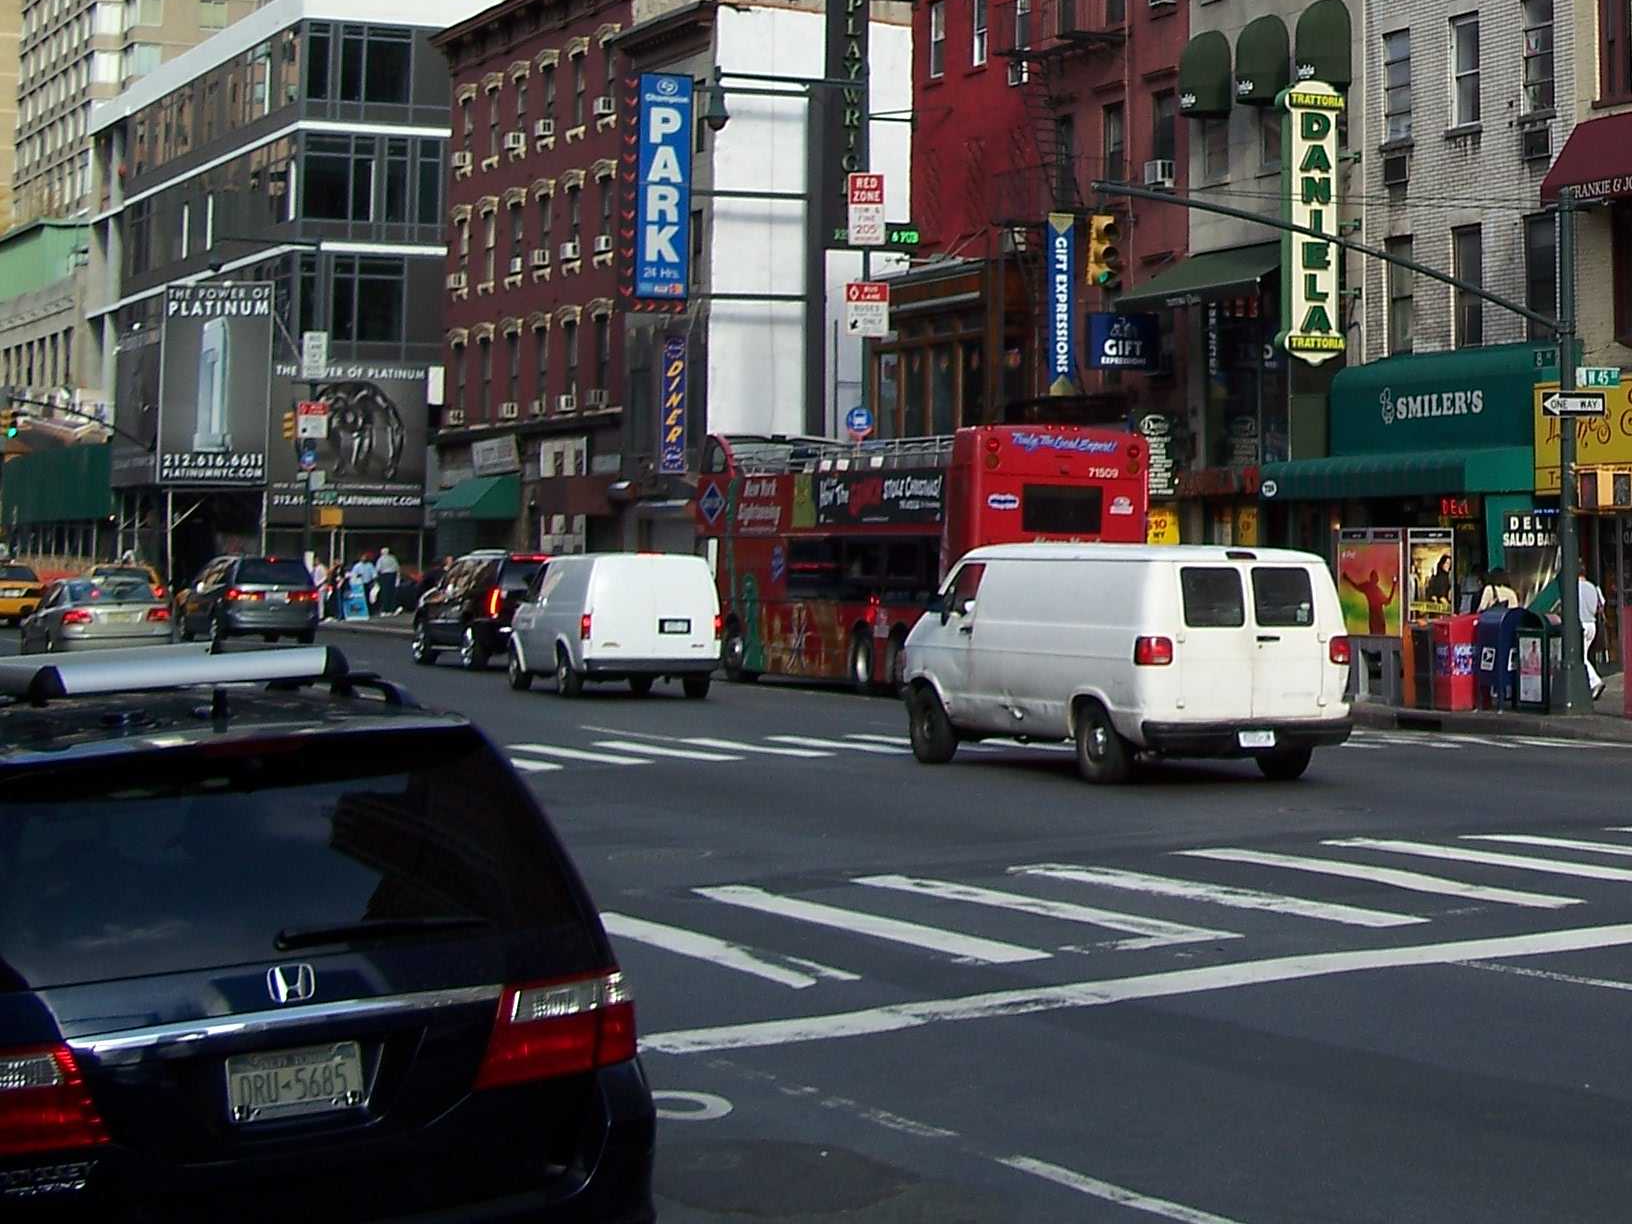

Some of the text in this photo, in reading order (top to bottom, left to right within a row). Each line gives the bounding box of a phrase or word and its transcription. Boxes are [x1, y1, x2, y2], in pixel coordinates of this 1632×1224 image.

[644, 92, 690, 105] Champion
[1290, 93, 1345, 107] TRATTORIA
[645, 106, 683, 264] PARK
[855, 177, 878, 189] RED
[1569, 179, 1611, 200] FRANKIE
[1612, 178, 1622, 193] &
[853, 190, 881, 202] ZONE
[1299, 111, 1333, 333] DANIELA
[643, 266, 657, 278] 24
[168, 287, 272, 300] THE POWER OF
[167, 300, 270, 317] PLATINUM
[1055, 236, 1069, 374] GIFT EXPRESSIONS
[1103, 338, 1144, 357] GIFT
[1290, 336, 1345, 350] TRATTORIA
[275, 364, 298, 376] THE
[367, 367, 427, 380] PLATINUM
[1588, 370, 1596, 385] W
[1597, 370, 1609, 385] 45
[664, 359, 685, 443] DINER
[1395, 389, 1484, 420] SMILER'S
[1550, 399, 1599, 409] ONE WAY
[162, 453, 264, 467] 212.616.6611
[161, 467, 263, 479] PLATINUMNYC.COM
[1088, 466, 1120, 479] 71509
[1502, 532, 1536, 548] SALAD
[239, 1061, 348, 1106] DRU 5685
